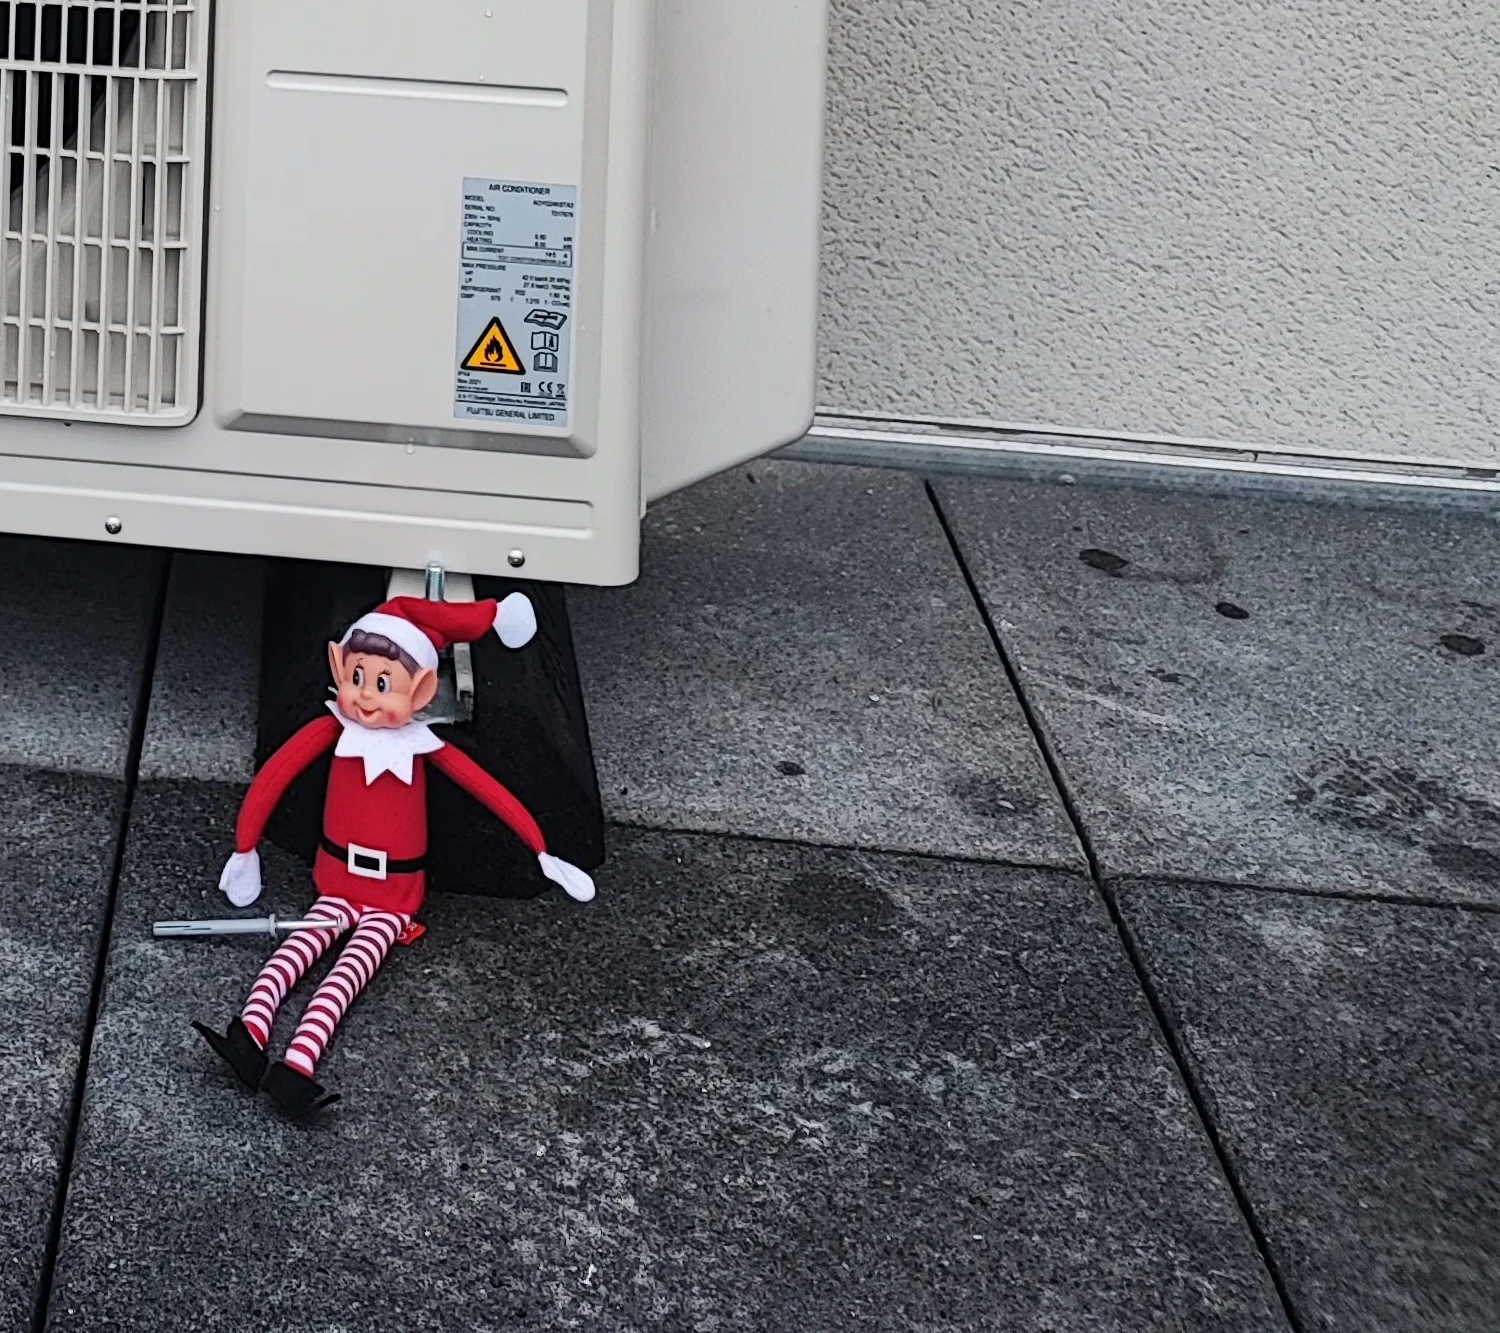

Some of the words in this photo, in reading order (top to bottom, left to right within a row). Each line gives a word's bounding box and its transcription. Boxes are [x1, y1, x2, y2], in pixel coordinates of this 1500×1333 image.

[488, 183, 501, 191] AIR
[502, 184, 551, 195] CONDITIONER
[466, 406, 494, 416] FUJITSU
